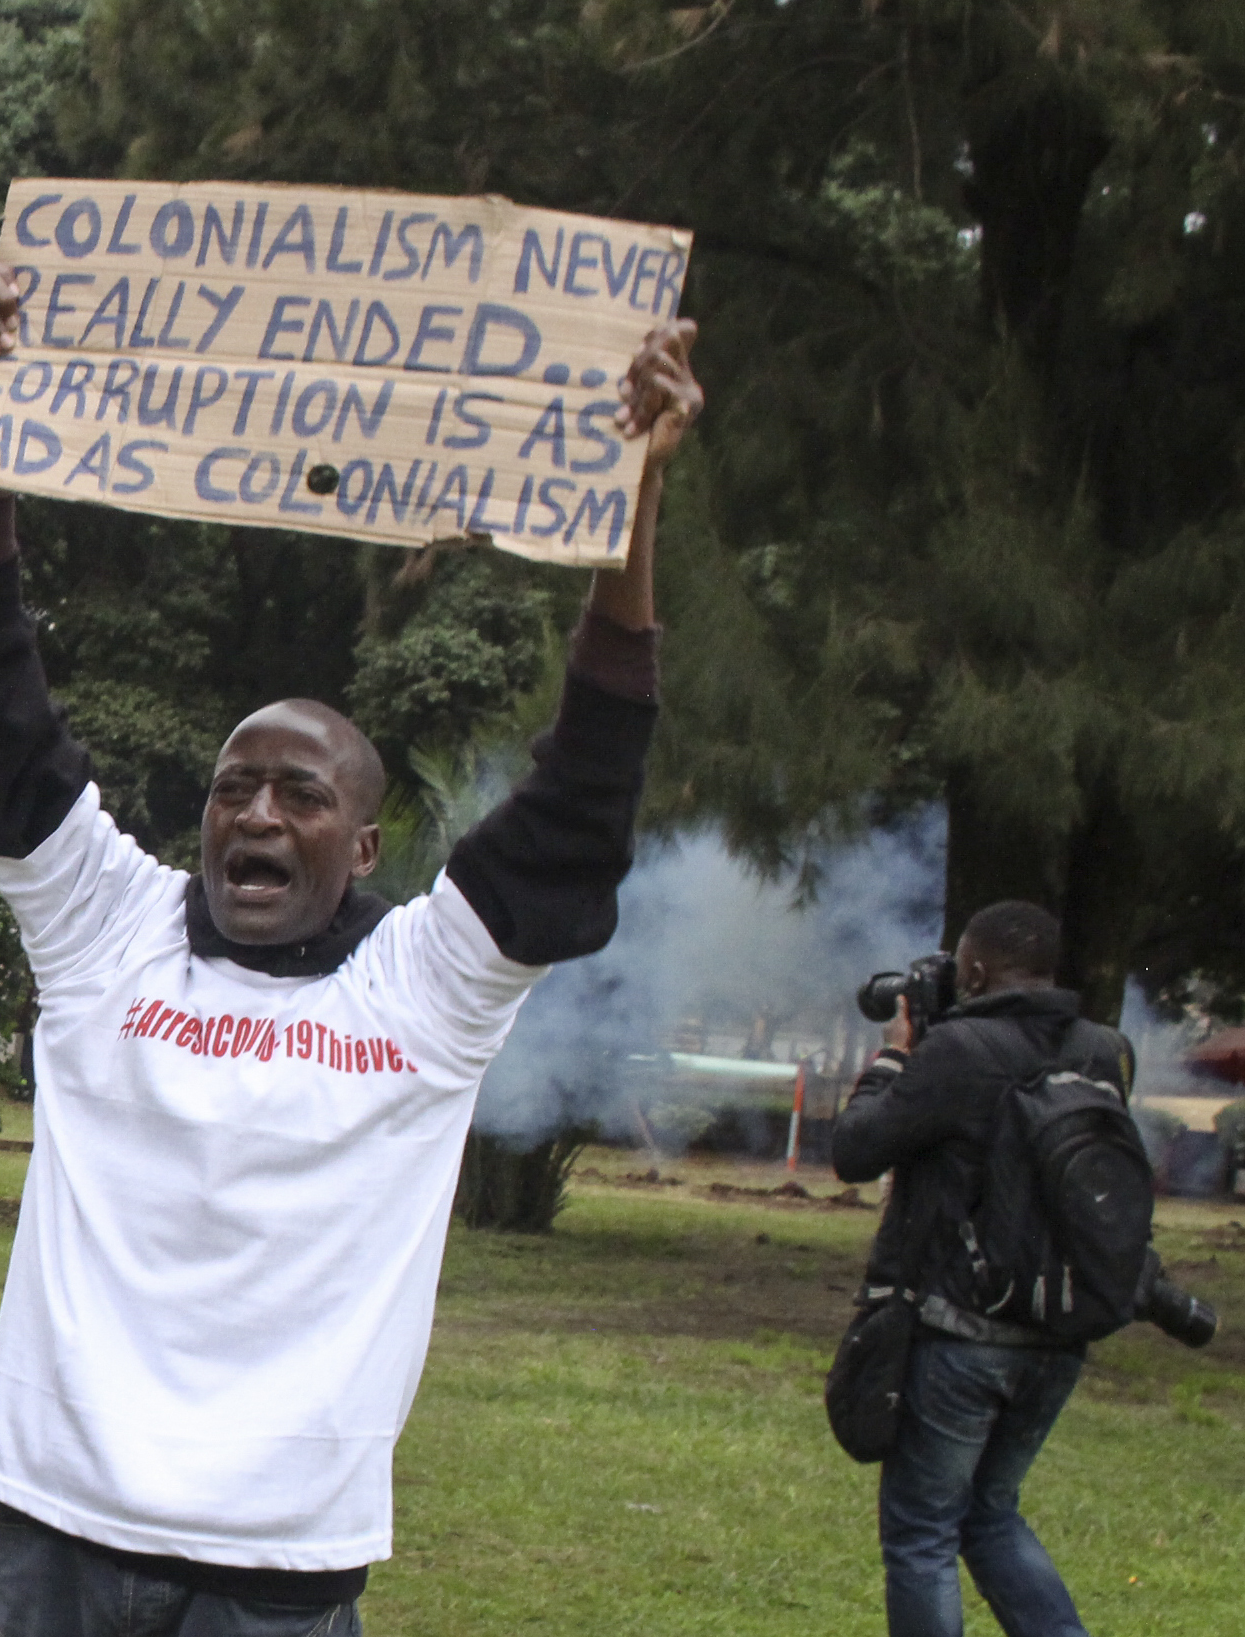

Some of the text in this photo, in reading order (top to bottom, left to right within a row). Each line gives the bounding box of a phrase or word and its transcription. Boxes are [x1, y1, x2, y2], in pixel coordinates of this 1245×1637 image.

[13, 265, 246, 355] REALLY
[16, 194, 686, 321] COLONIALISM NEVER
[425, 386, 506, 449] IS
[517, 395, 623, 474] AS
[62, 430, 169, 495] AS
[194, 446, 628, 554] COLONIALISM
